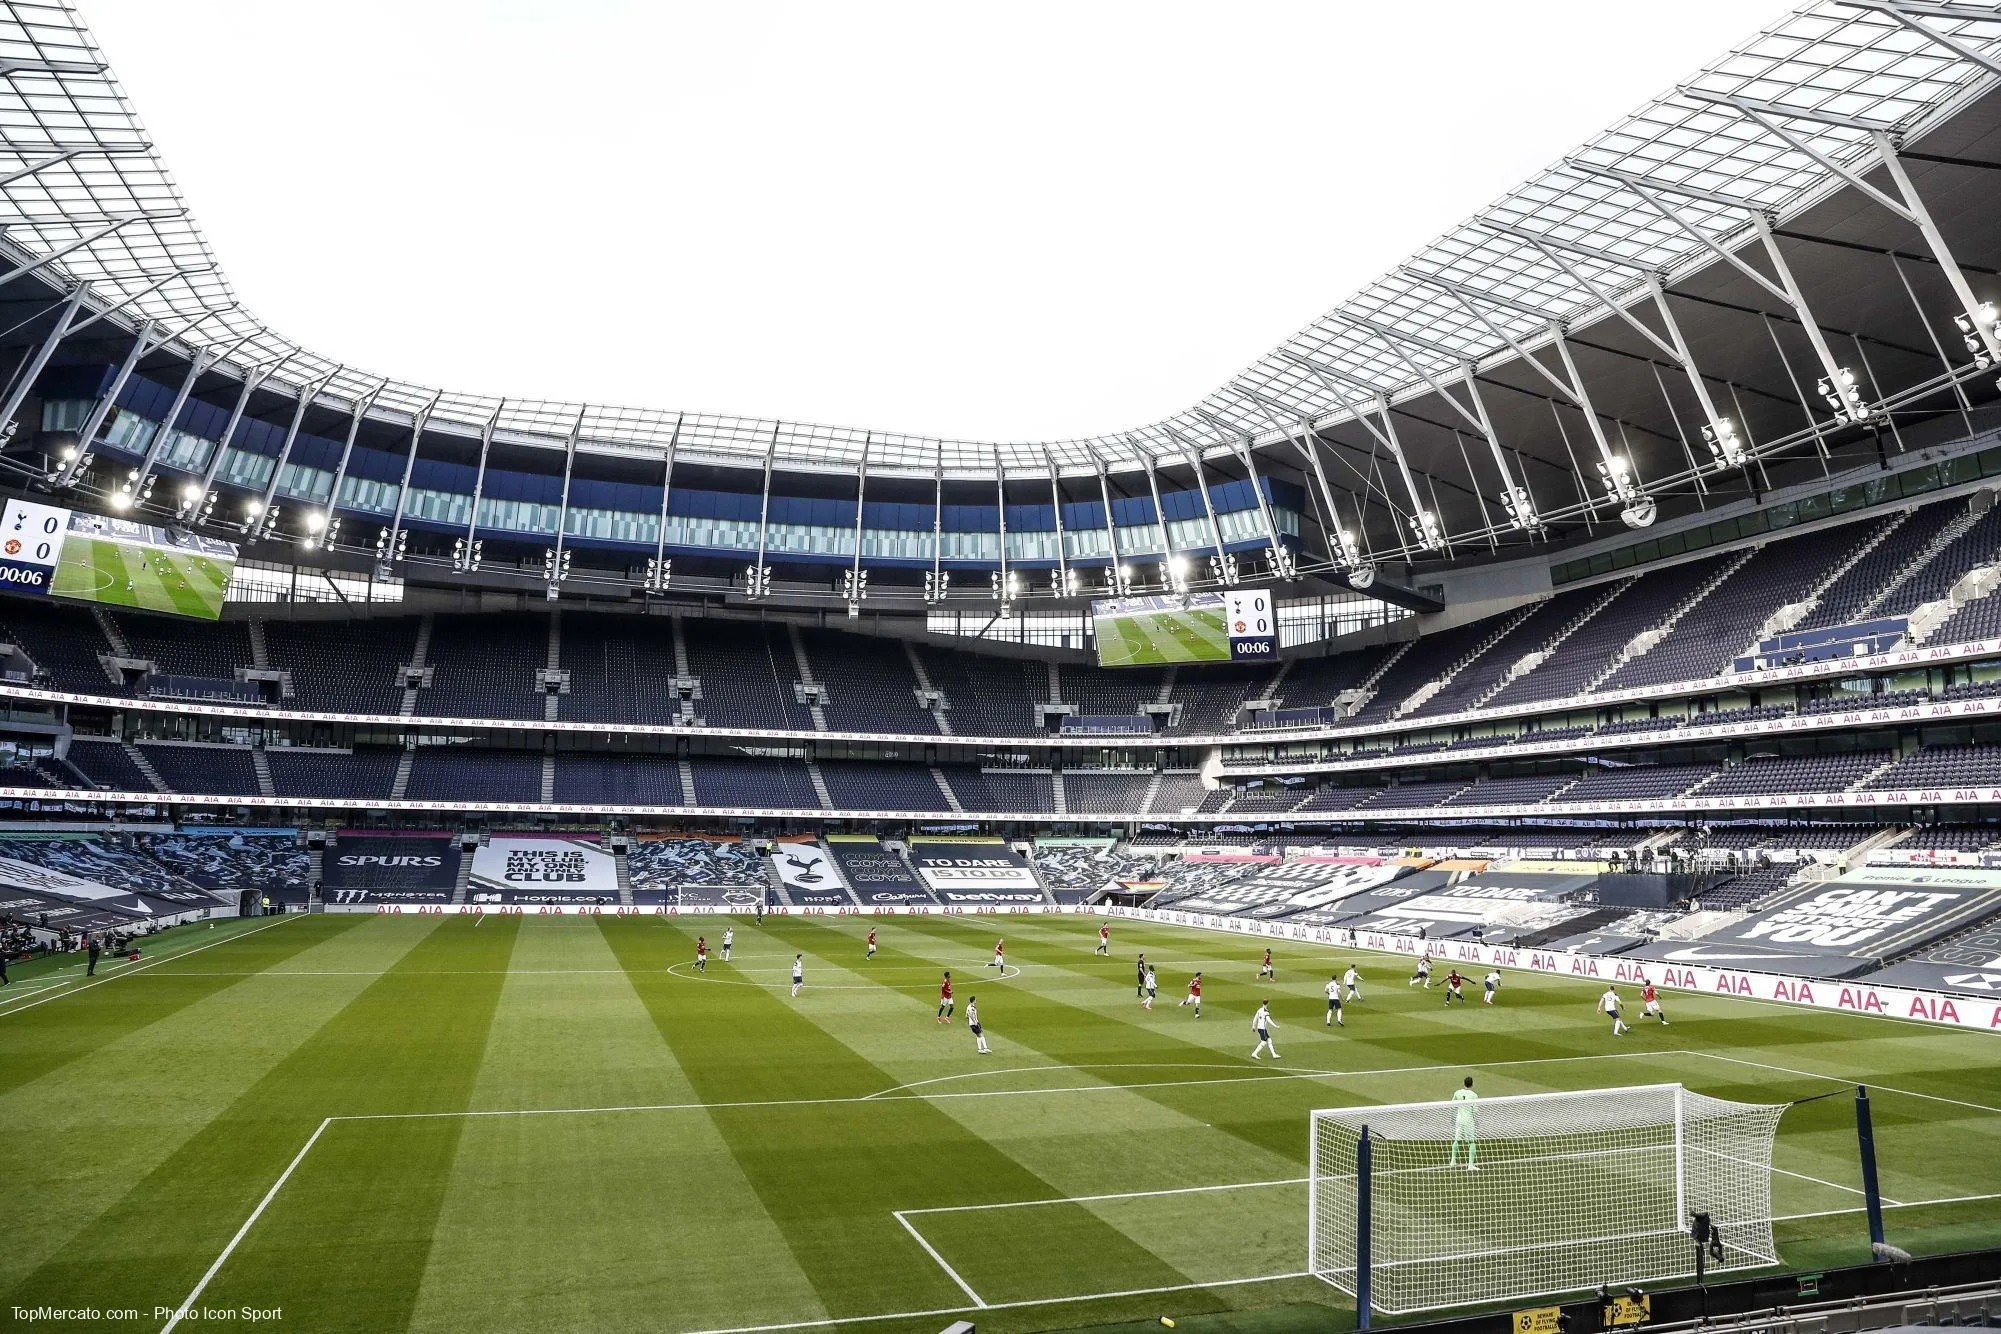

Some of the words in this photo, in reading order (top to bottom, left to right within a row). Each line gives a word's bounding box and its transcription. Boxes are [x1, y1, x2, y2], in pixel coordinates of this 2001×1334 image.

[44, 517, 58, 534] 0
[36, 542, 51, 559] 0
[0, 566, 43, 586] 00:06
[1254, 597, 1264, 611] 0
[1257, 618, 1267, 632] 0
[1237, 642, 1269, 654] 00:06
[1715, 677, 1729, 686] AIA
[1738, 675, 1753, 683] AIA
[1762, 671, 1778, 681] AIA
[1787, 668, 1803, 677] AIA
[1813, 664, 1830, 673] AIA
[1841, 660, 1858, 670] AIA
[1869, 656, 1888, 667] AIA
[1899, 652, 1918, 662] AIA
[1931, 647, 1950, 658] AIA
[1964, 643, 1985, 654] AIA
[1768, 721, 1783, 731] AIA
[1792, 719, 1807, 727] AIA
[1817, 716, 1833, 726] AIA
[1844, 714, 1861, 724] AIA
[1872, 711, 1890, 721] AIA
[1901, 708, 1920, 718] AIA
[1932, 705, 1951, 715] AIA
[1964, 702, 1984, 712] AIA
[1695, 800, 1710, 808] AIA
[1719, 799, 1734, 807] AIA
[1744, 798, 1760, 806] AIA
[1770, 797, 1787, 805] AIA
[1798, 796, 1815, 804] AIA
[1826, 795, 1844, 804] AIA
[1856, 794, 1875, 803] AIA
[1887, 793, 1907, 802] AIA
[1920, 791, 1941, 801] AIA
[1955, 790, 1978, 800] AIA
[337, 855, 442, 867] SPURS
[922, 859, 952, 867] TO
[955, 859, 1013, 867] DARE
[504, 872, 586, 882] CLUB
[931, 869, 952, 877] IS
[955, 869, 982, 877] TO
[1933, 876, 1987, 885] League
[947, 892, 1042, 902] betway
[1813, 889, 1961, 907] CAN'T
[378, 905, 401, 915] AIA
[419, 905, 442, 915] AIA
[460, 906, 483, 915] AIA
[500, 906, 523, 915] AIA
[540, 906, 562, 915] AIA
[579, 906, 601, 915] AIA
[617, 906, 639, 915] AIA
[694, 906, 714, 915] AIA
[768, 906, 788, 915] AIA
[804, 907, 824, 915] AIA
[839, 907, 859, 915] AIA
[874, 907, 894, 915] AIA
[909, 907, 929, 915] AIA
[943, 907, 962, 915] AIA
[977, 907, 996, 915] AIA
[1010, 907, 1029, 915] AIA
[1043, 906, 1061, 915] AIA
[1782, 901, 1933, 920] SMILE
[1765, 913, 1905, 929] WITHOUT
[1736, 921, 1884, 946] YOU
[1249, 920, 1261, 934] AIA
[1269, 922, 1284, 936] AIA
[1293, 925, 1307, 939] AIA
[1316, 926, 1331, 942] AIA
[1368, 935, 1385, 949] AIA
[1396, 936, 1414, 953] AIA
[1427, 939, 1447, 957] AIA
[1459, 945, 1480, 962] AIA
[1493, 949, 1516, 967] AIA
[1531, 953, 1556, 971] AIA
[1572, 957, 1599, 977] AIA
[1615, 962, 1645, 982] AIA
[1664, 968, 1697, 988] AIA
[1716, 974, 1752, 995] AIA
[1774, 980, 1815, 1004] AIA
[1838, 988, 1883, 1013] AIA
[1909, 996, 1960, 1023] AIA
[1534, 1324, 1557, 1332] FOOTBALLS
